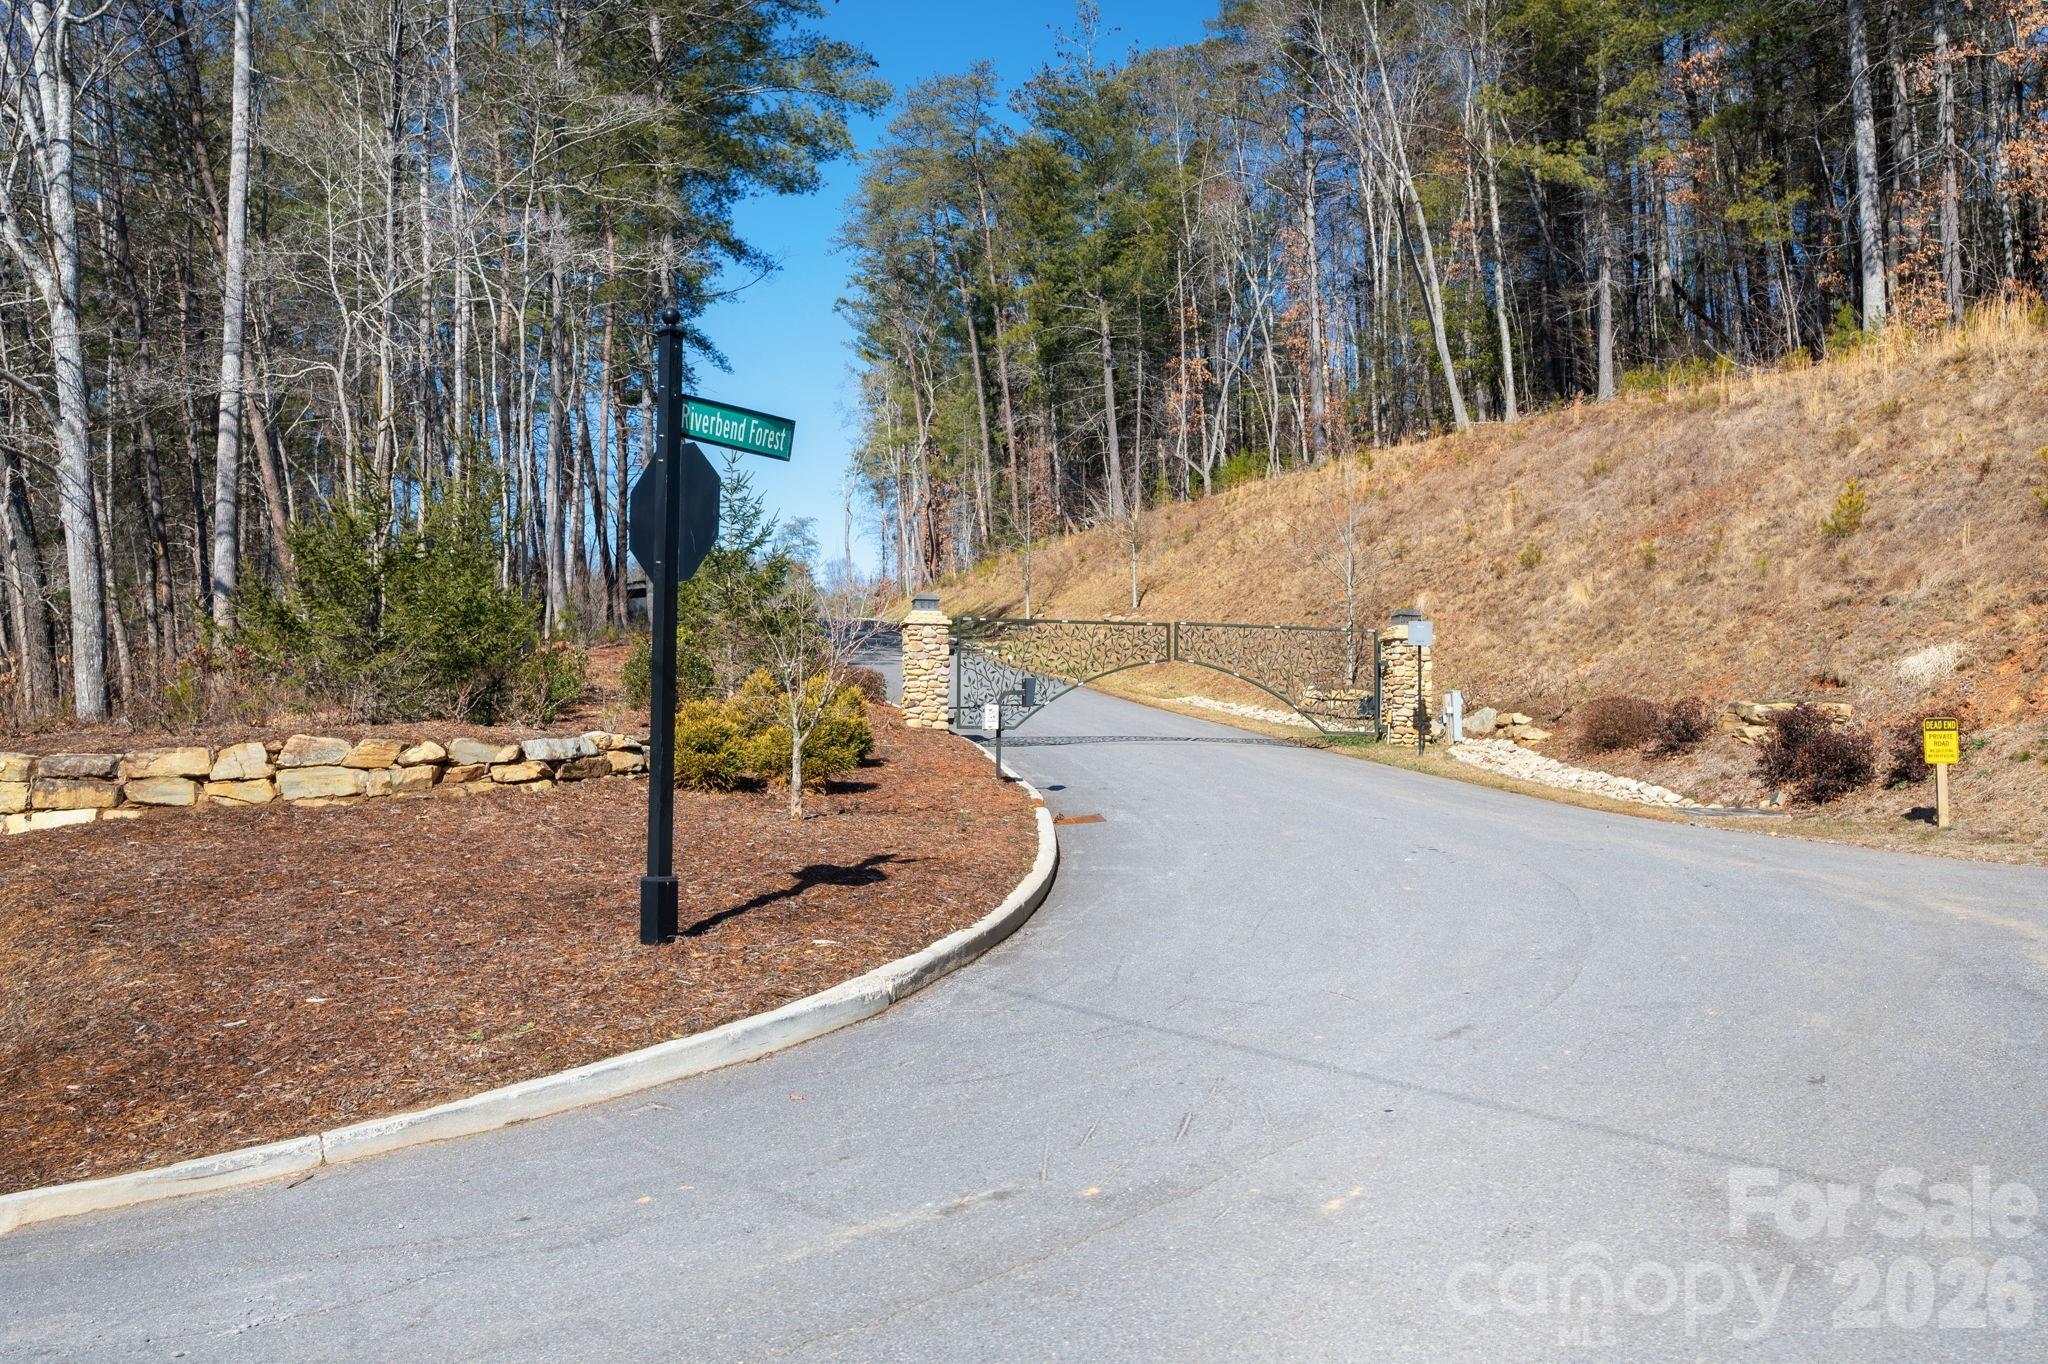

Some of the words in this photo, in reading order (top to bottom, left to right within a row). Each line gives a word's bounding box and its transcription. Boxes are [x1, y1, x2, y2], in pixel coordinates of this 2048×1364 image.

[681, 403, 747, 442] Riverbend
[748, 418, 787, 451] Forest
[1925, 720, 1943, 729] DEAD
[1943, 720, 1956, 729] END
